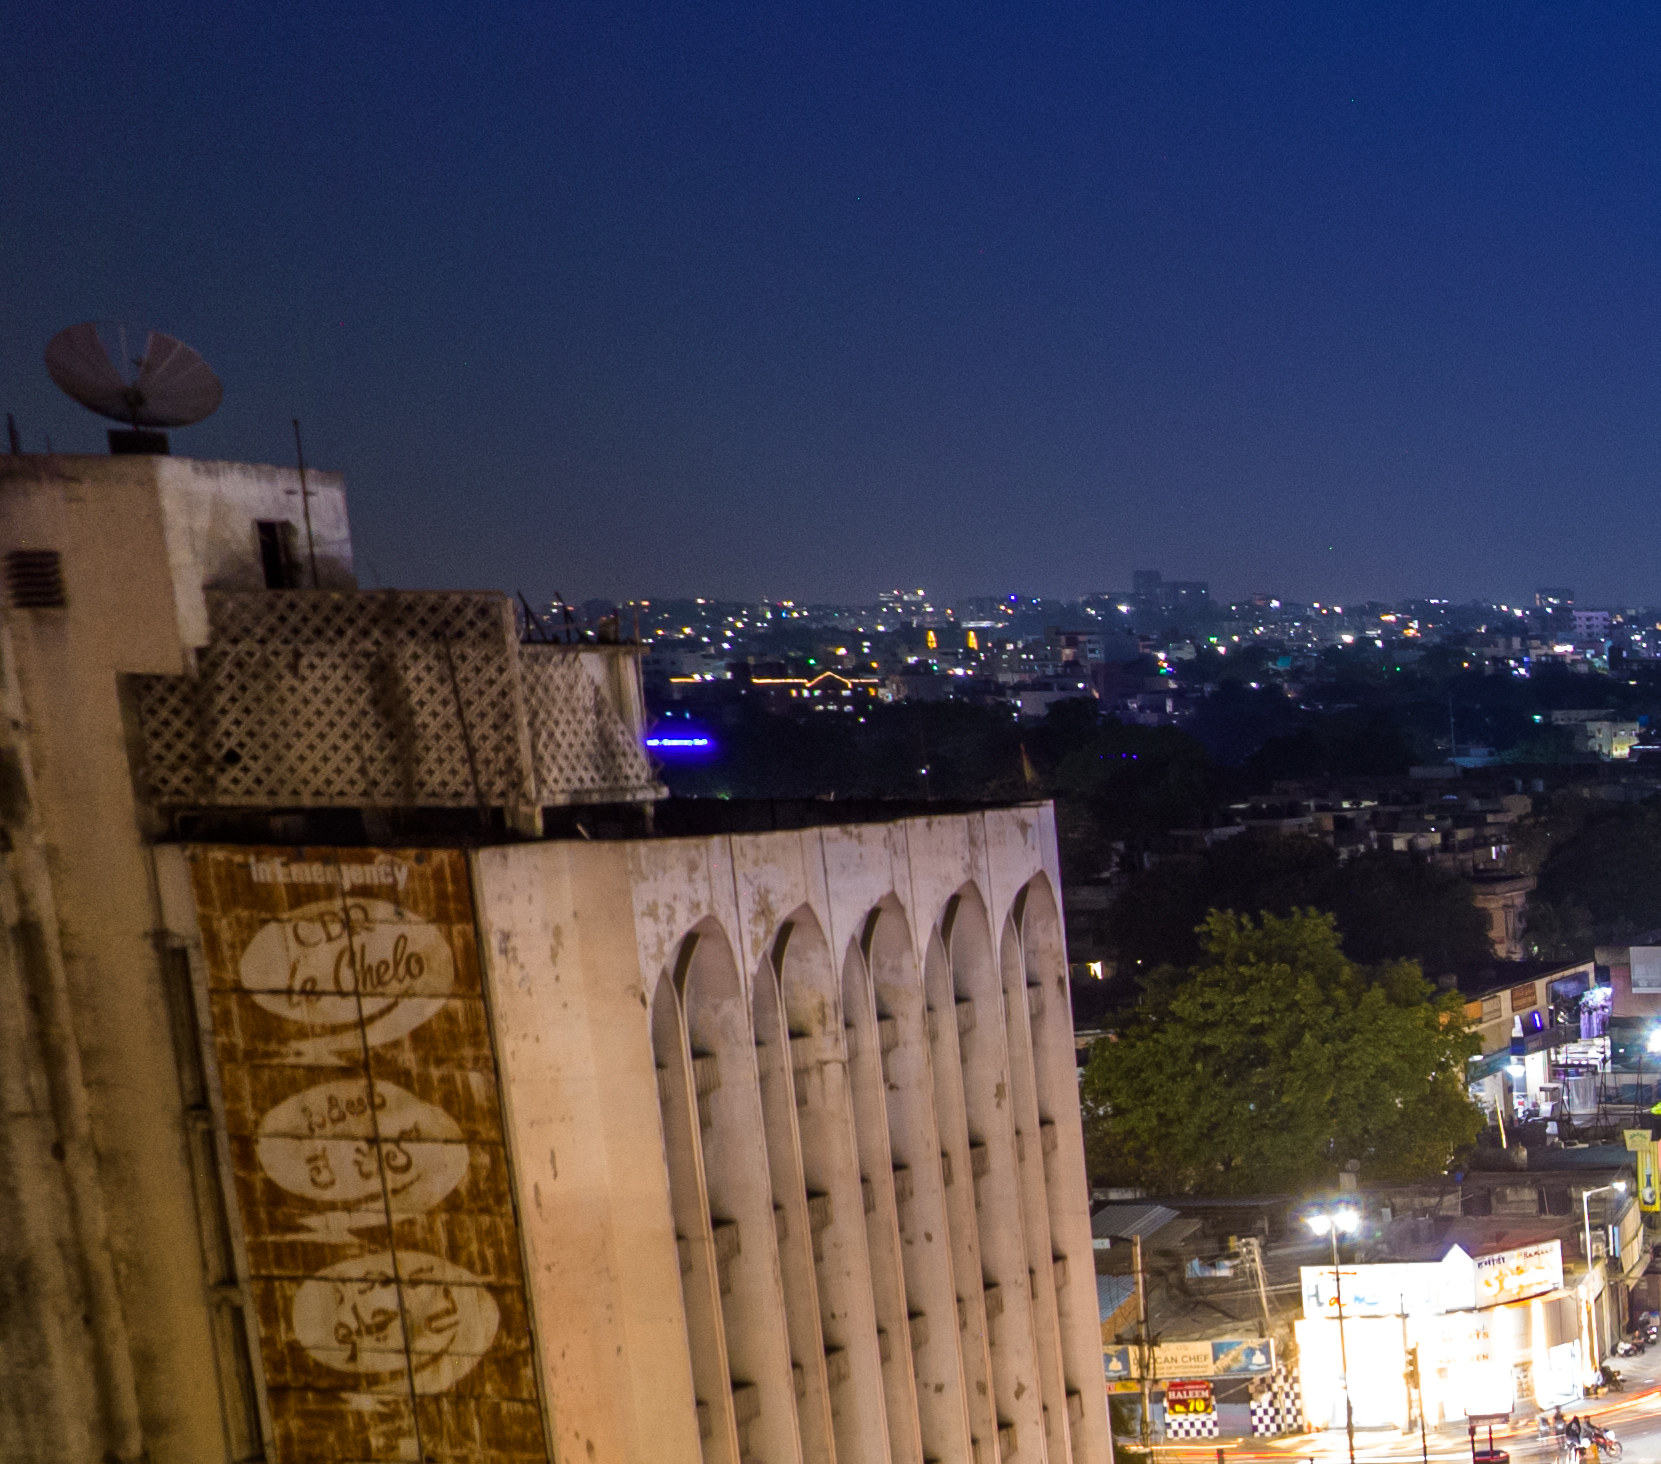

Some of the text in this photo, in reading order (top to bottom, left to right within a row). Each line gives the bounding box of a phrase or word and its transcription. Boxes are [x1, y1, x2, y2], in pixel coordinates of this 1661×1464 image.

[1181, 1353, 1209, 1363] CHEF
[1168, 1389, 1210, 1400] HALEEM
[1187, 1398, 1205, 1412] 70
